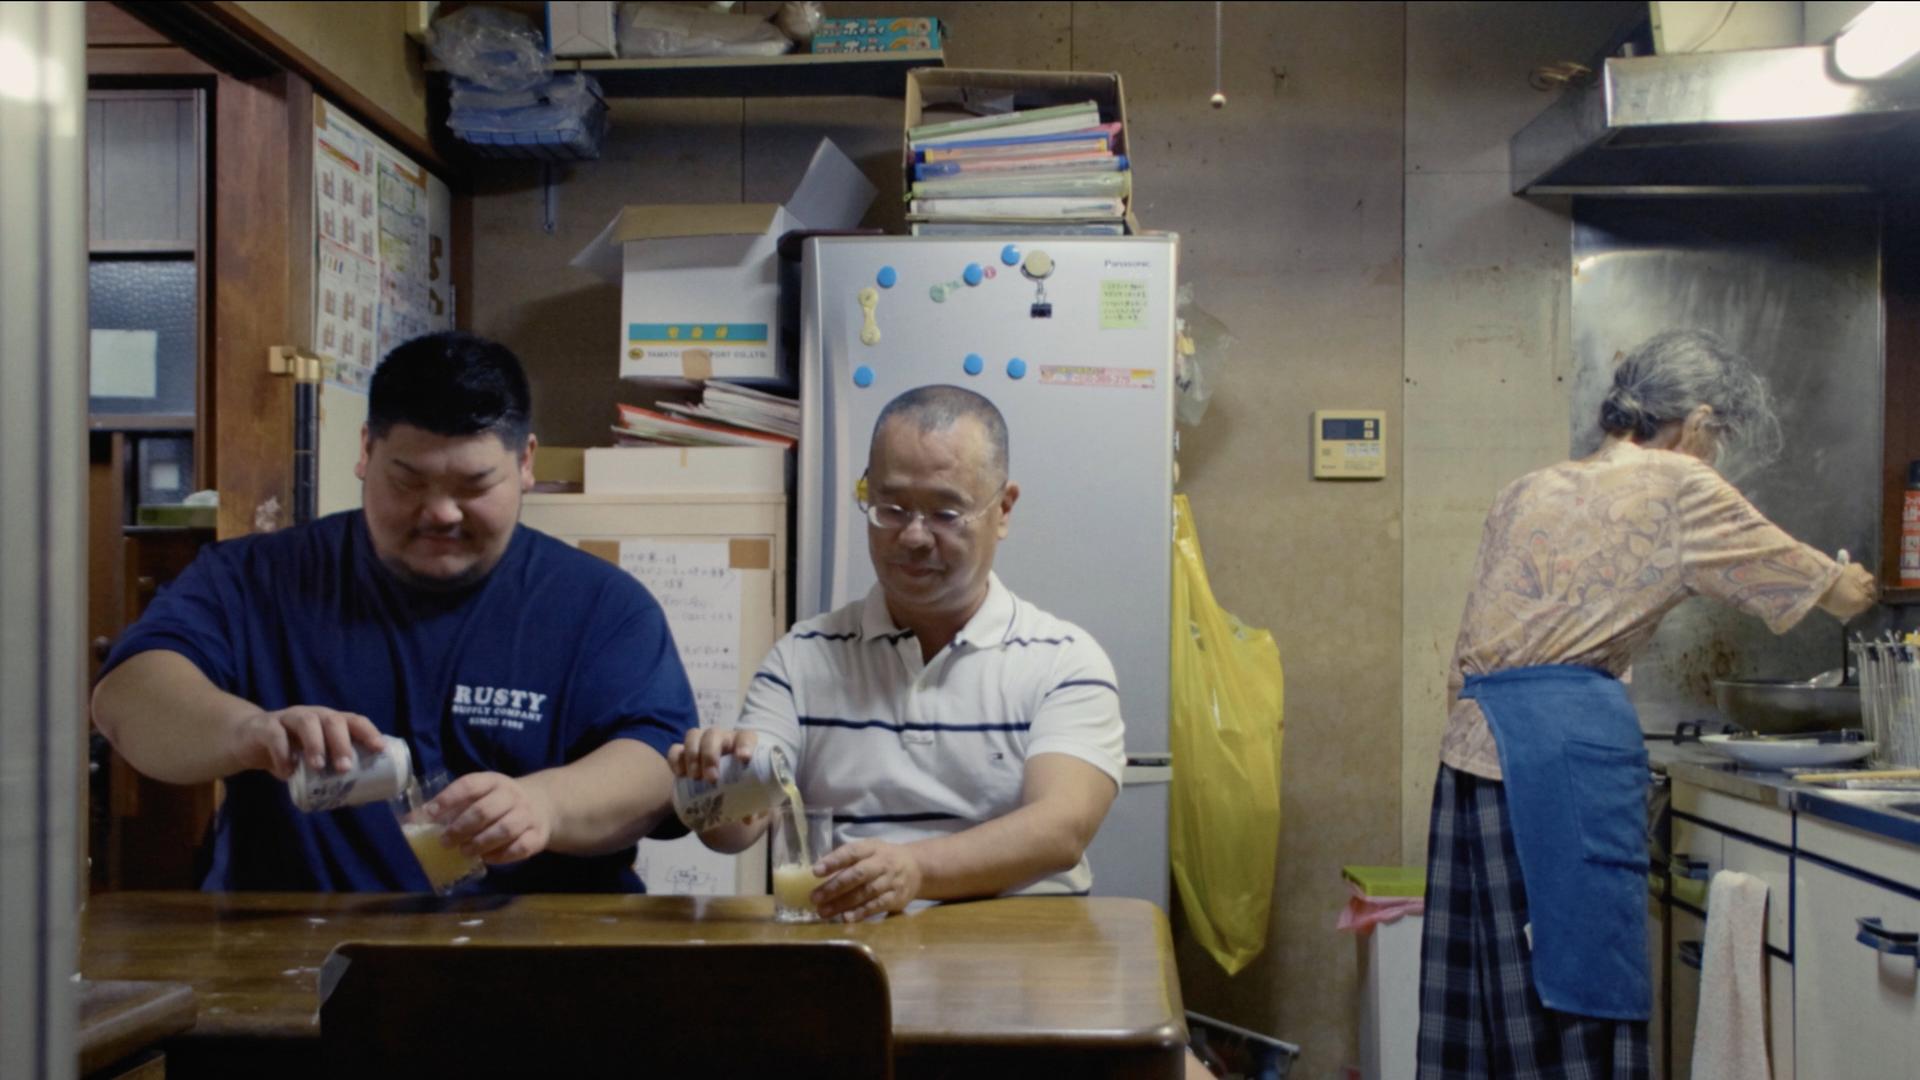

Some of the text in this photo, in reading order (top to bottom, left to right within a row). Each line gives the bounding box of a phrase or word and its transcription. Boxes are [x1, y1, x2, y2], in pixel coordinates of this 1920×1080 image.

[453, 684, 547, 712] RUSTY
[451, 704, 543, 722] SUPPLY COMPANY
